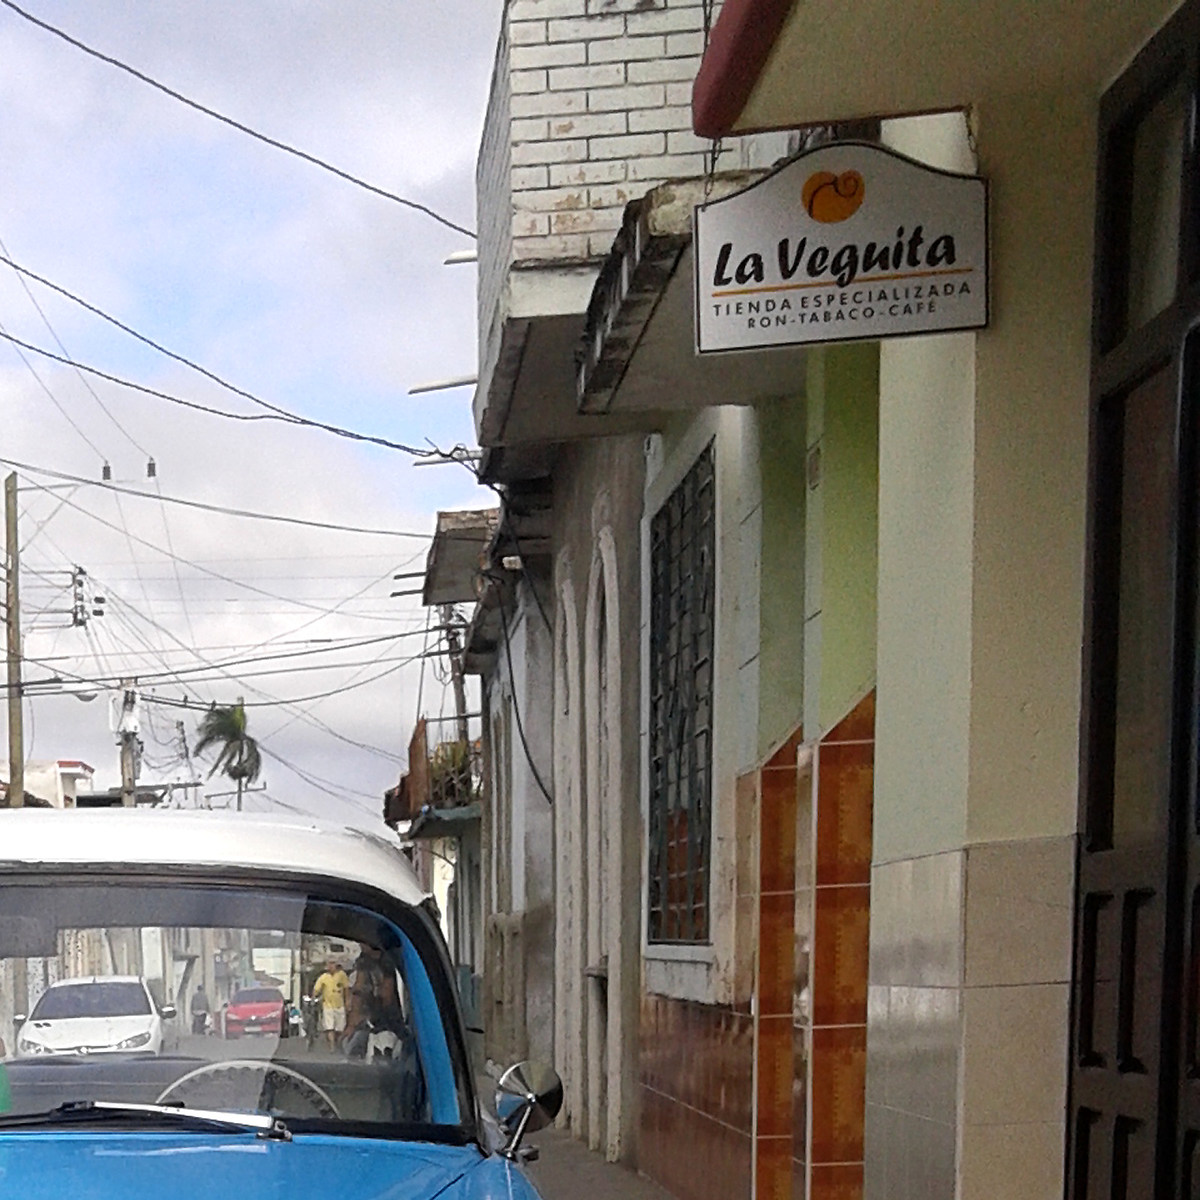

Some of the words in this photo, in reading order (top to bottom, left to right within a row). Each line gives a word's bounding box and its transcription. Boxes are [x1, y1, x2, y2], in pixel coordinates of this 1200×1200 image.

[712, 242, 765, 287] La
[777, 225, 958, 288] Veguita
[712, 299, 792, 317] TIENDA
[800, 281, 973, 309] ESPECIALIZADA
